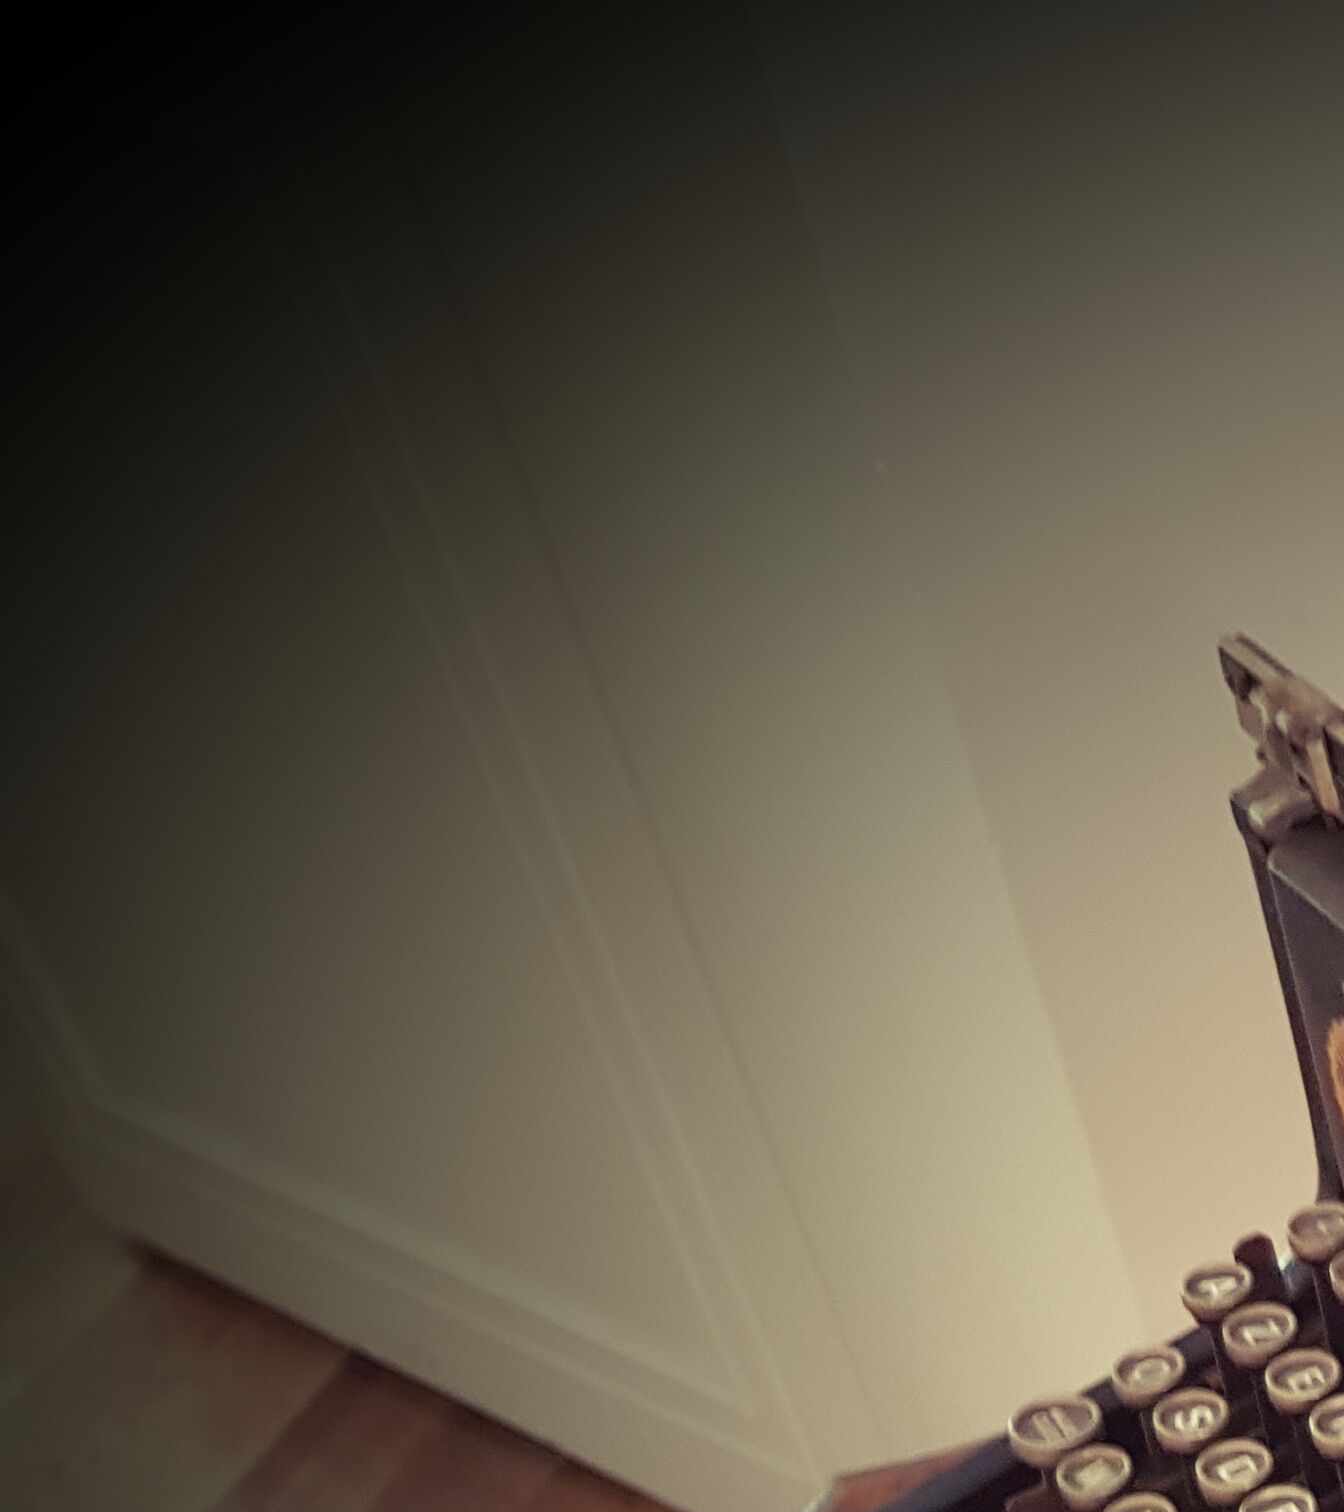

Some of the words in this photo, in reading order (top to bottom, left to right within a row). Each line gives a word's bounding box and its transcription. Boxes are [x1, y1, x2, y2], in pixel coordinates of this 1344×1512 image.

[1242, 1321, 1282, 1346] Z
[1289, 1366, 1326, 1391] E
[1174, 1405, 1212, 1430] S
